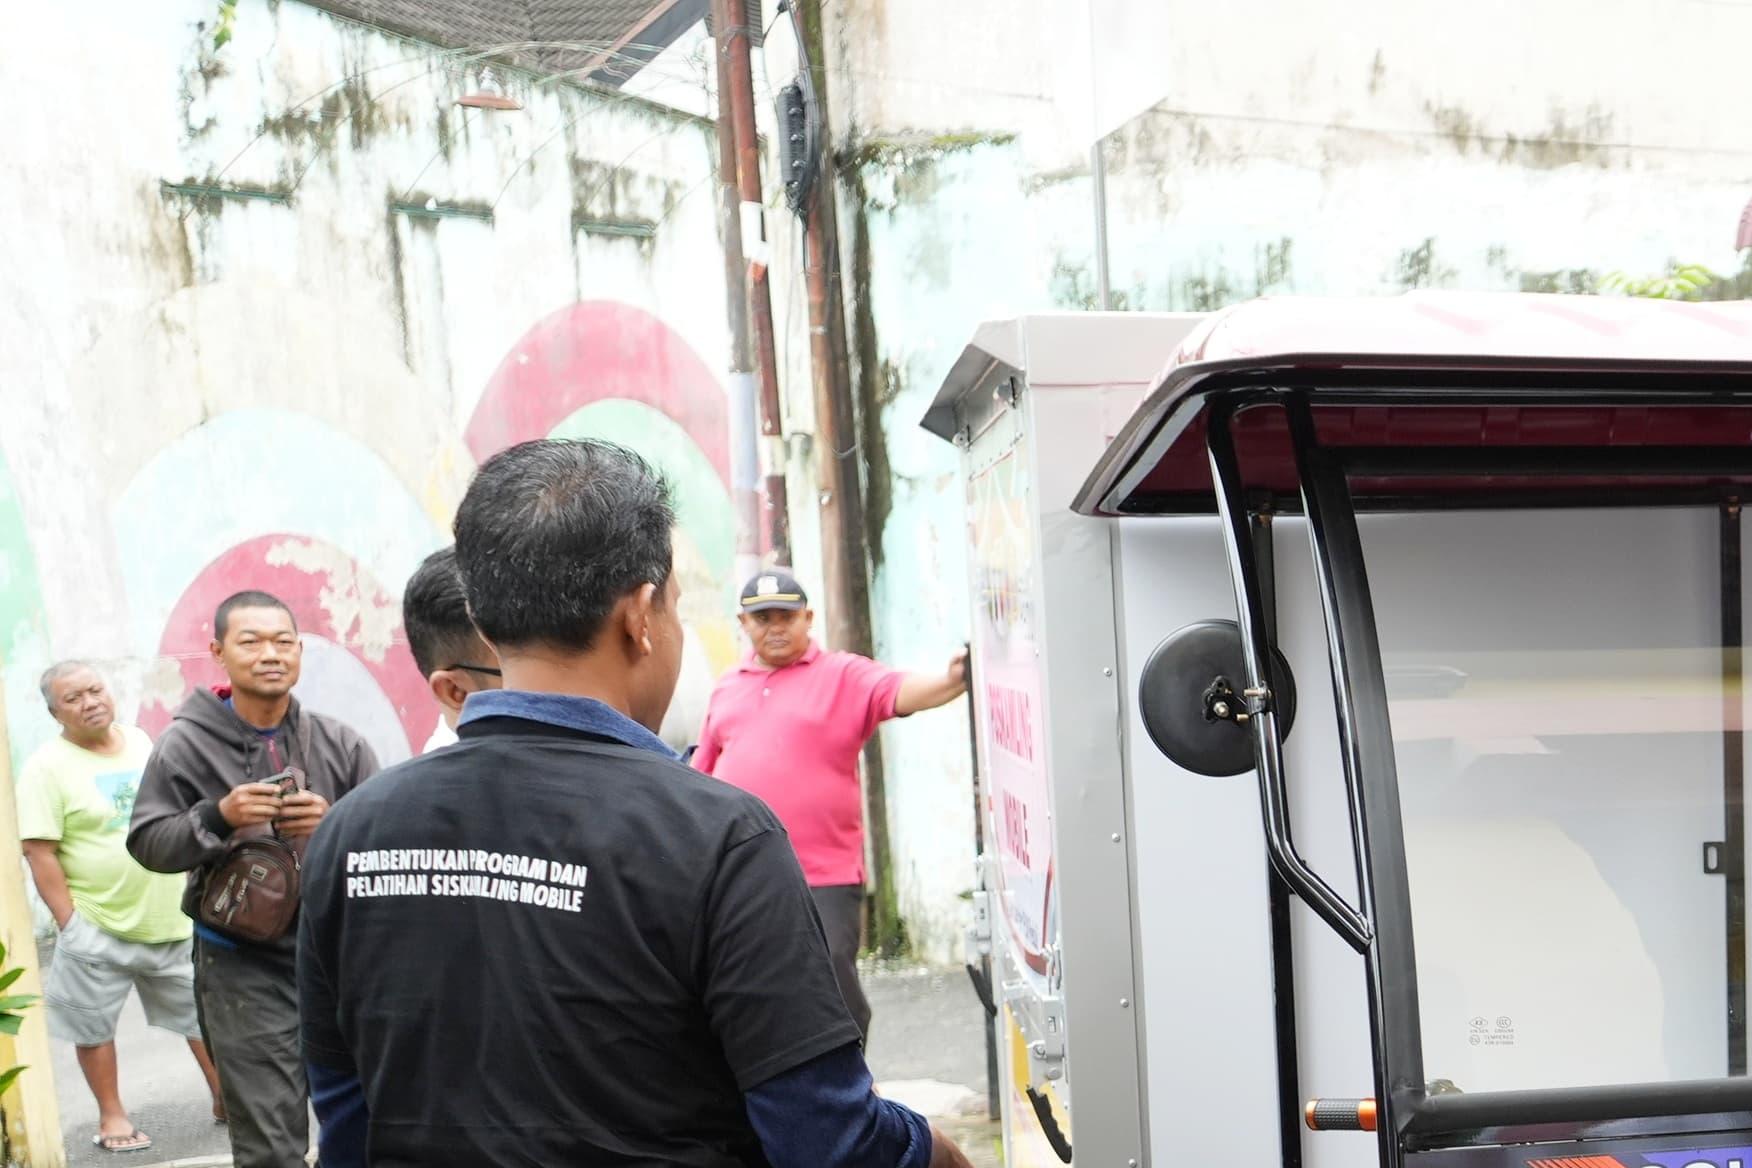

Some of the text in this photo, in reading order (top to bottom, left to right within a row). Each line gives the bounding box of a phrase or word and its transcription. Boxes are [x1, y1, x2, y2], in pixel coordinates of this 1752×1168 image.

[1002, 787, 1031, 870] MOBILE
[346, 850, 468, 873] PEMBENTUKAN
[549, 861, 588, 887] DAN
[346, 875, 428, 898] PELATIHAN
[519, 883, 583, 912] MOBILE
